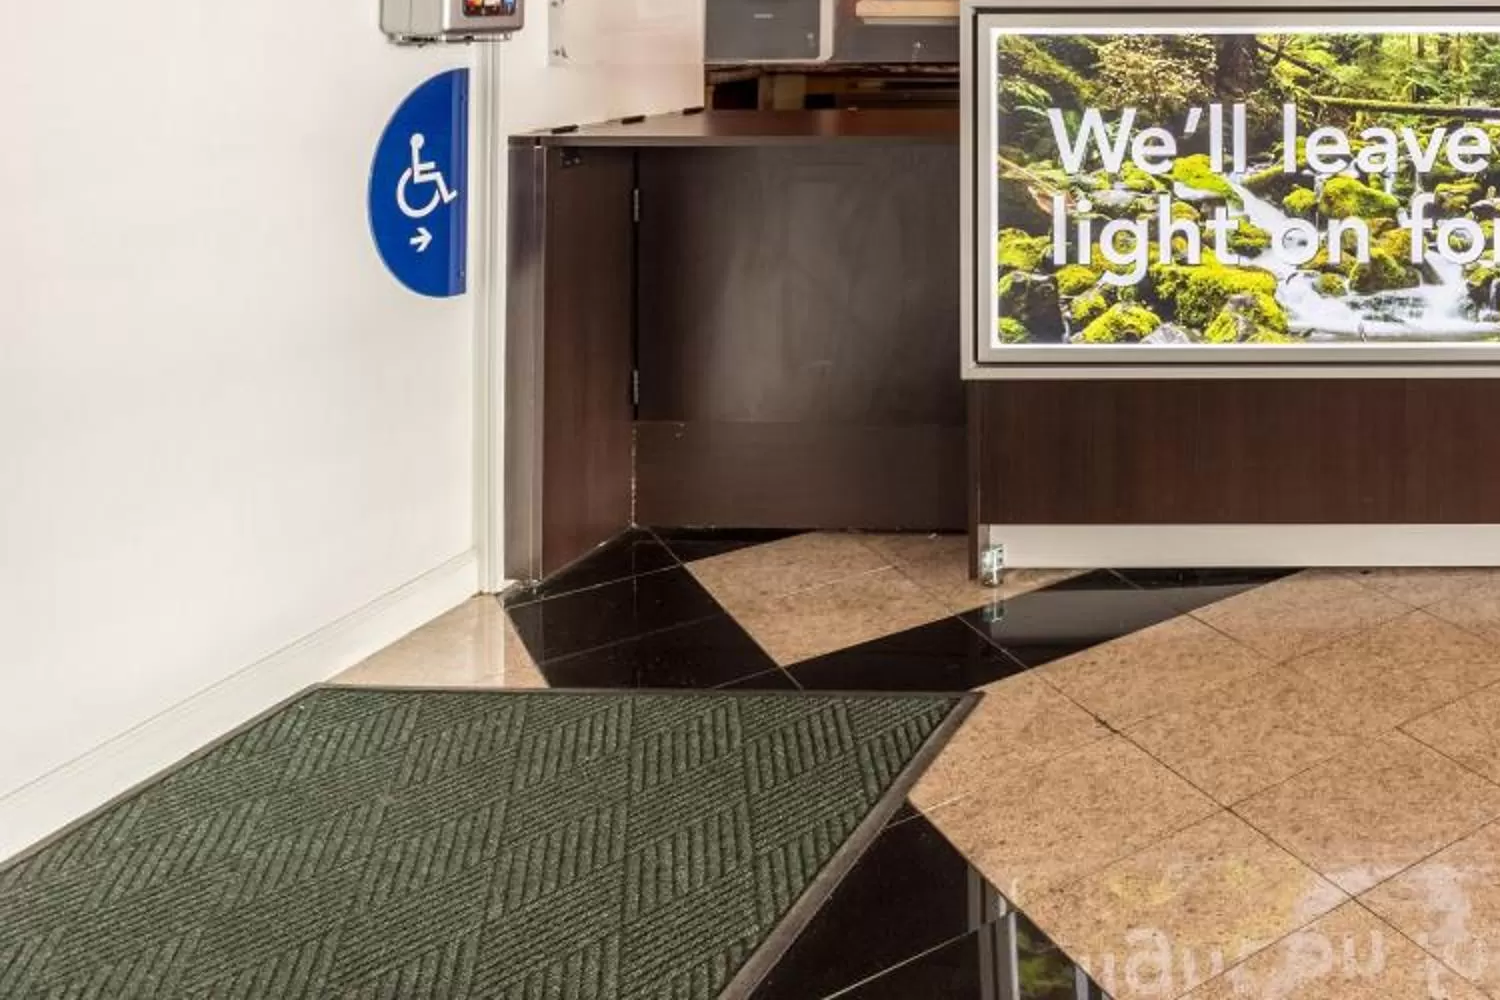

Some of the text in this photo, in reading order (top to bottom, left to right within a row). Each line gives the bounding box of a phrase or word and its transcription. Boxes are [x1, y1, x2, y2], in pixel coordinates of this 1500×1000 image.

[1047, 103, 1246, 175] We'll
[1283, 103, 1491, 175] leave
[1053, 194, 1239, 287] light
[1270, 216, 1370, 266] on
